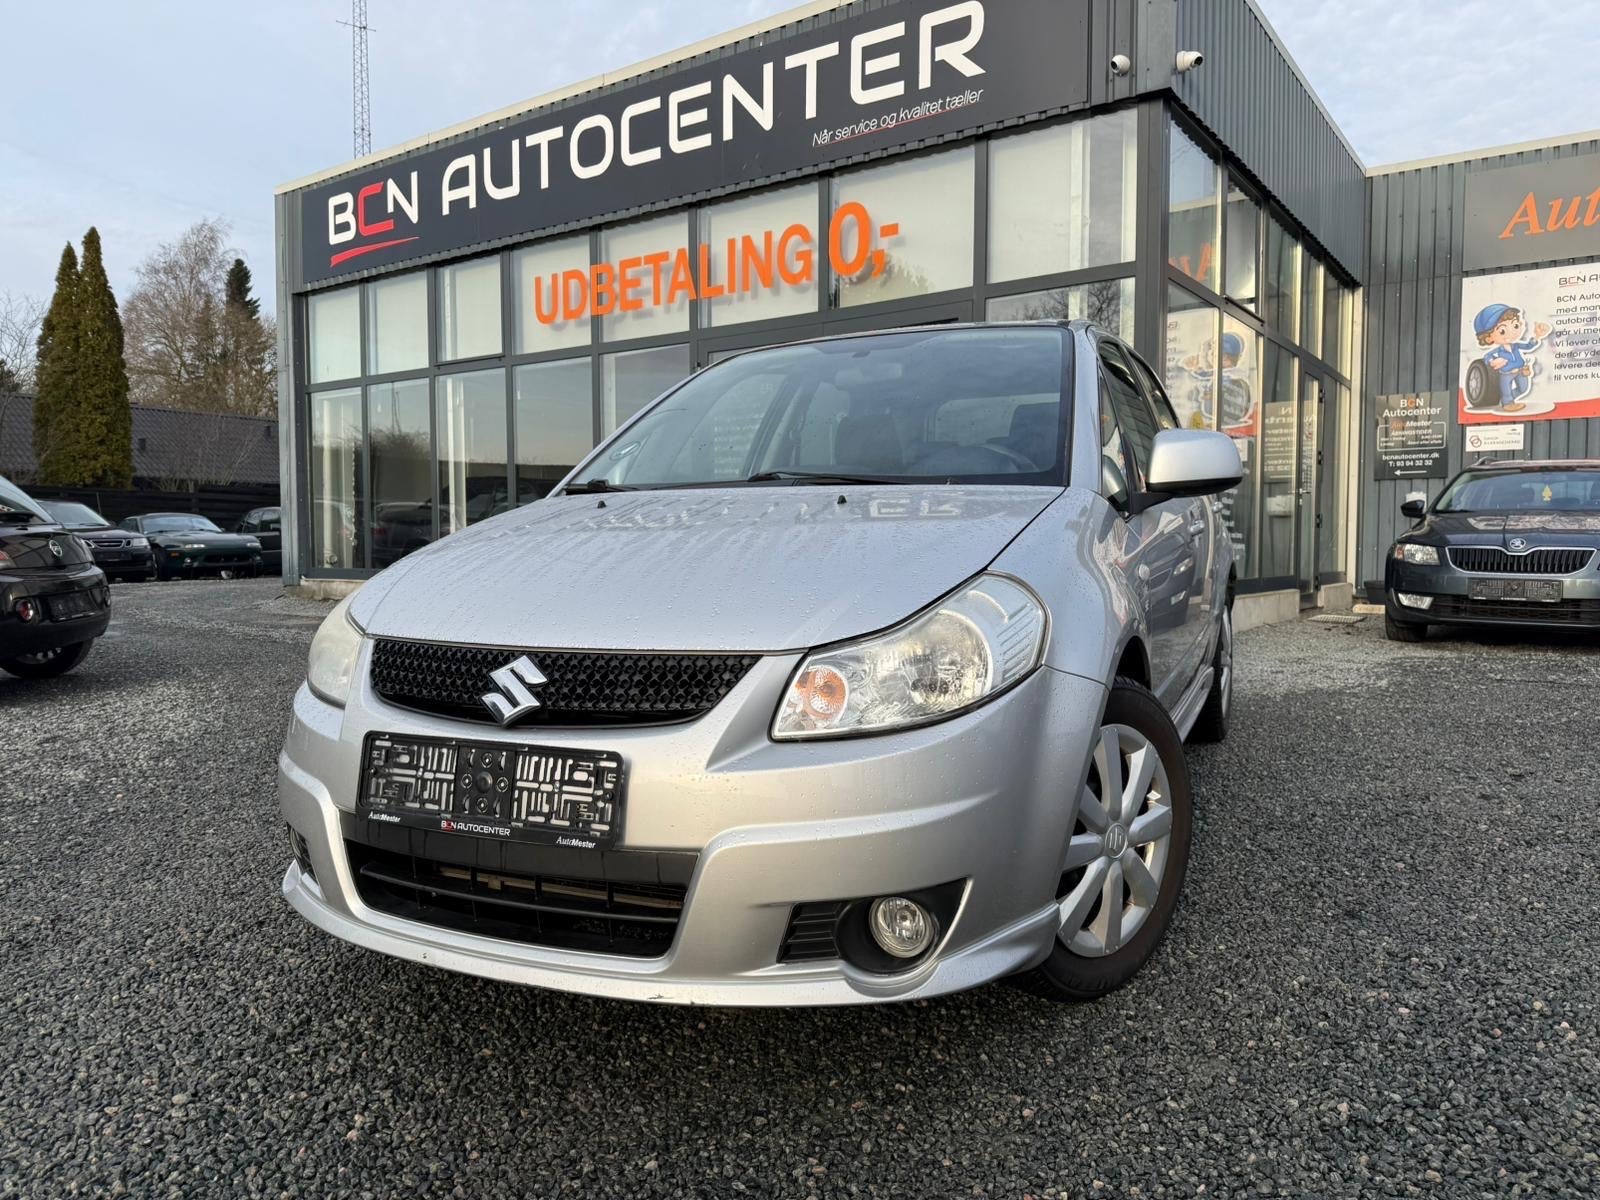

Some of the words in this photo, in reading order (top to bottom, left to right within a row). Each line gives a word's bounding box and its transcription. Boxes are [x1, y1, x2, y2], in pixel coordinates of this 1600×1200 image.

[812, 128, 835, 147] Når
[834, 119, 878, 141] service
[880, 112, 897, 128] og
[899, 99, 943, 122] kvalitet
[945, 88, 984, 110] tæller
[327, 170, 419, 246] BCN
[441, 0, 987, 216] AUTOCENTER
[534, 223, 814, 325] UDBETALING
[1558, 274, 1586, 286] BCN
[1556, 294, 1577, 303] BCN
[1556, 305, 1577, 315] med
[1555, 327, 1571, 338] går
[1573, 327, 1581, 335] vi
[1583, 326, 1600, 335] me
[1555, 340, 1564, 348] Vi
[1566, 338, 1589, 346] lever
[1554, 349, 1582, 359] derfor
[1554, 361, 1583, 370] levere
[1563, 372, 1588, 380] vores
[1400, 398, 1424, 408] BCN
[1382, 407, 1442, 418] Autocenter
[1382, 451, 1440, 461] bcnautocenter.dk
[1415, 459, 1423, 467] 32
[368, 811, 401, 823] AutoMester
[440, 819, 457, 830] BCN
[457, 821, 511, 837] AUTOCENTER
[555, 835, 596, 849] AutoMester
